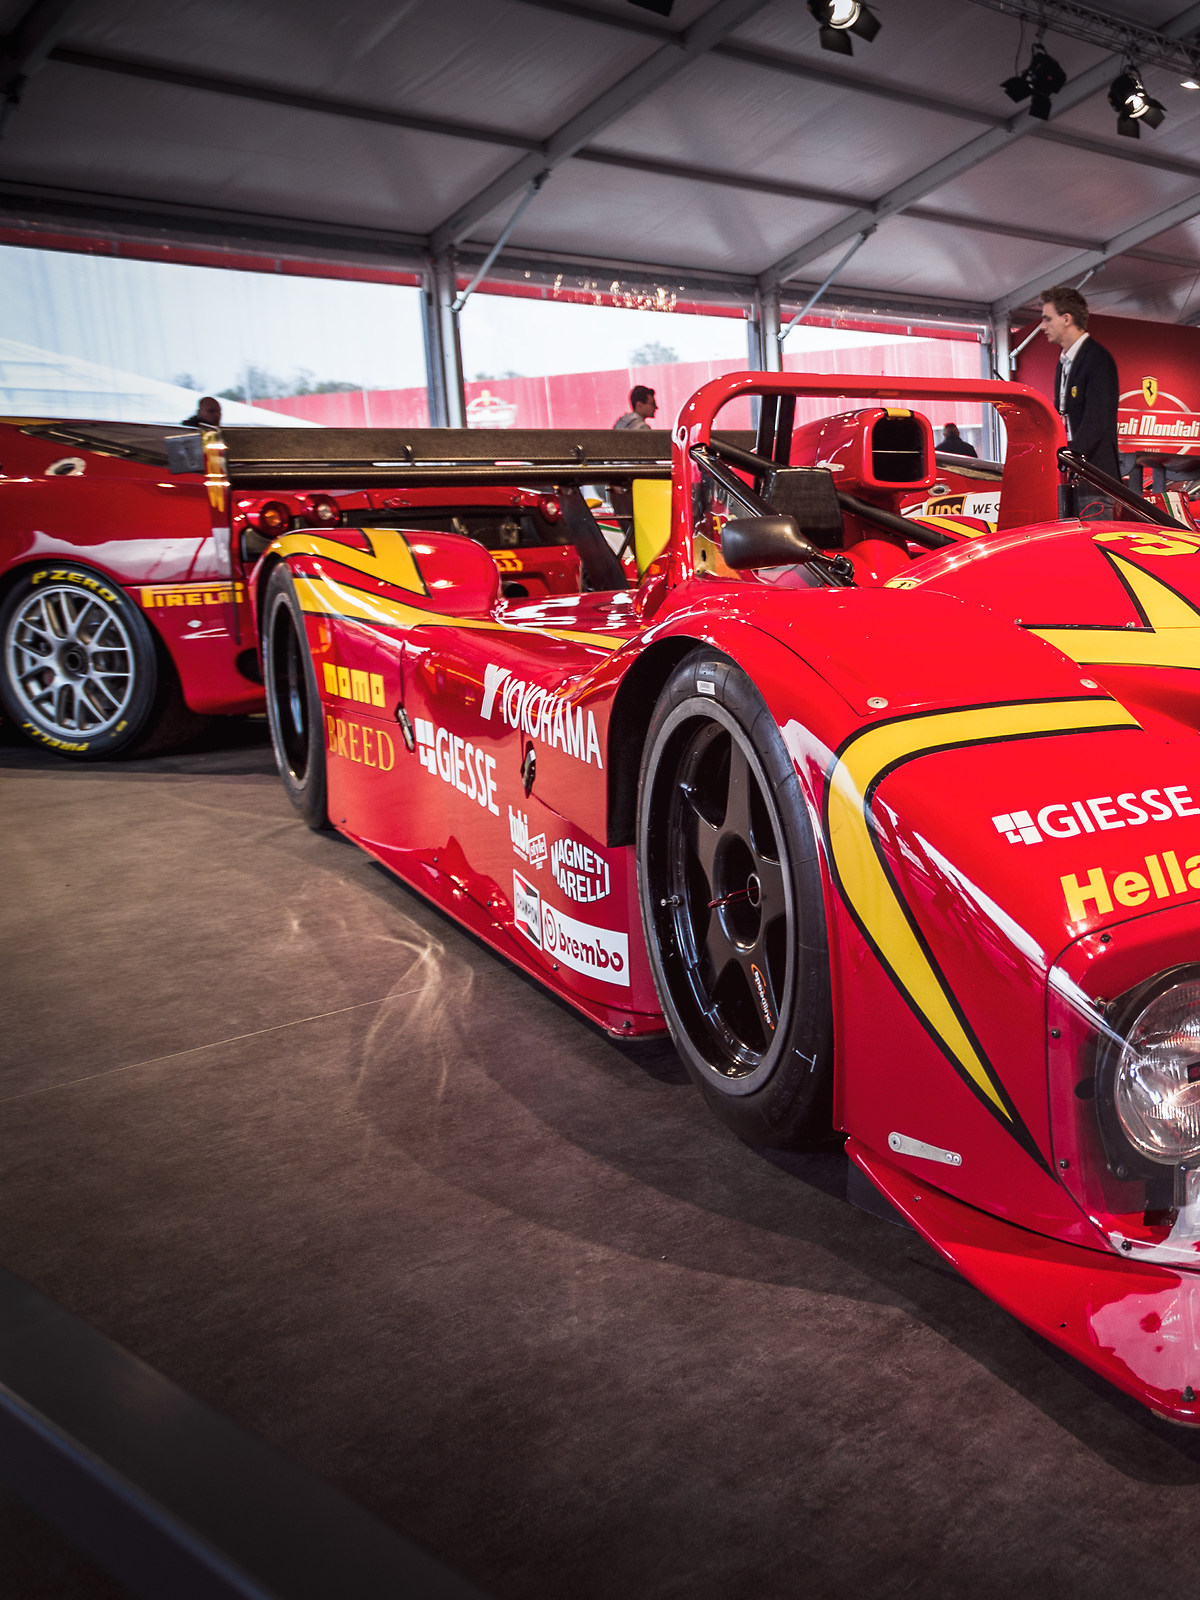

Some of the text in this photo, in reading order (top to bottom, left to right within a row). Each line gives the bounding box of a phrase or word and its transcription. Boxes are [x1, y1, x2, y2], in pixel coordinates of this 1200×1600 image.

[1139, 415, 1200, 437] Mondiali
[973, 503, 991, 514] WE
[32, 570, 121, 603] P ZERO
[22, 721, 90, 751] PIRELLI
[327, 714, 395, 772] BREED
[501, 675, 604, 769] YOKOHAMA
[436, 727, 499, 817] GIESSE
[508, 805, 529, 854] tubi
[1037, 785, 1200, 840] GIESSE
[551, 838, 611, 877] MAGNETI
[551, 865, 611, 903] MARELLI
[558, 923, 624, 972] brembo
[754, 970, 771, 1024] speedline
